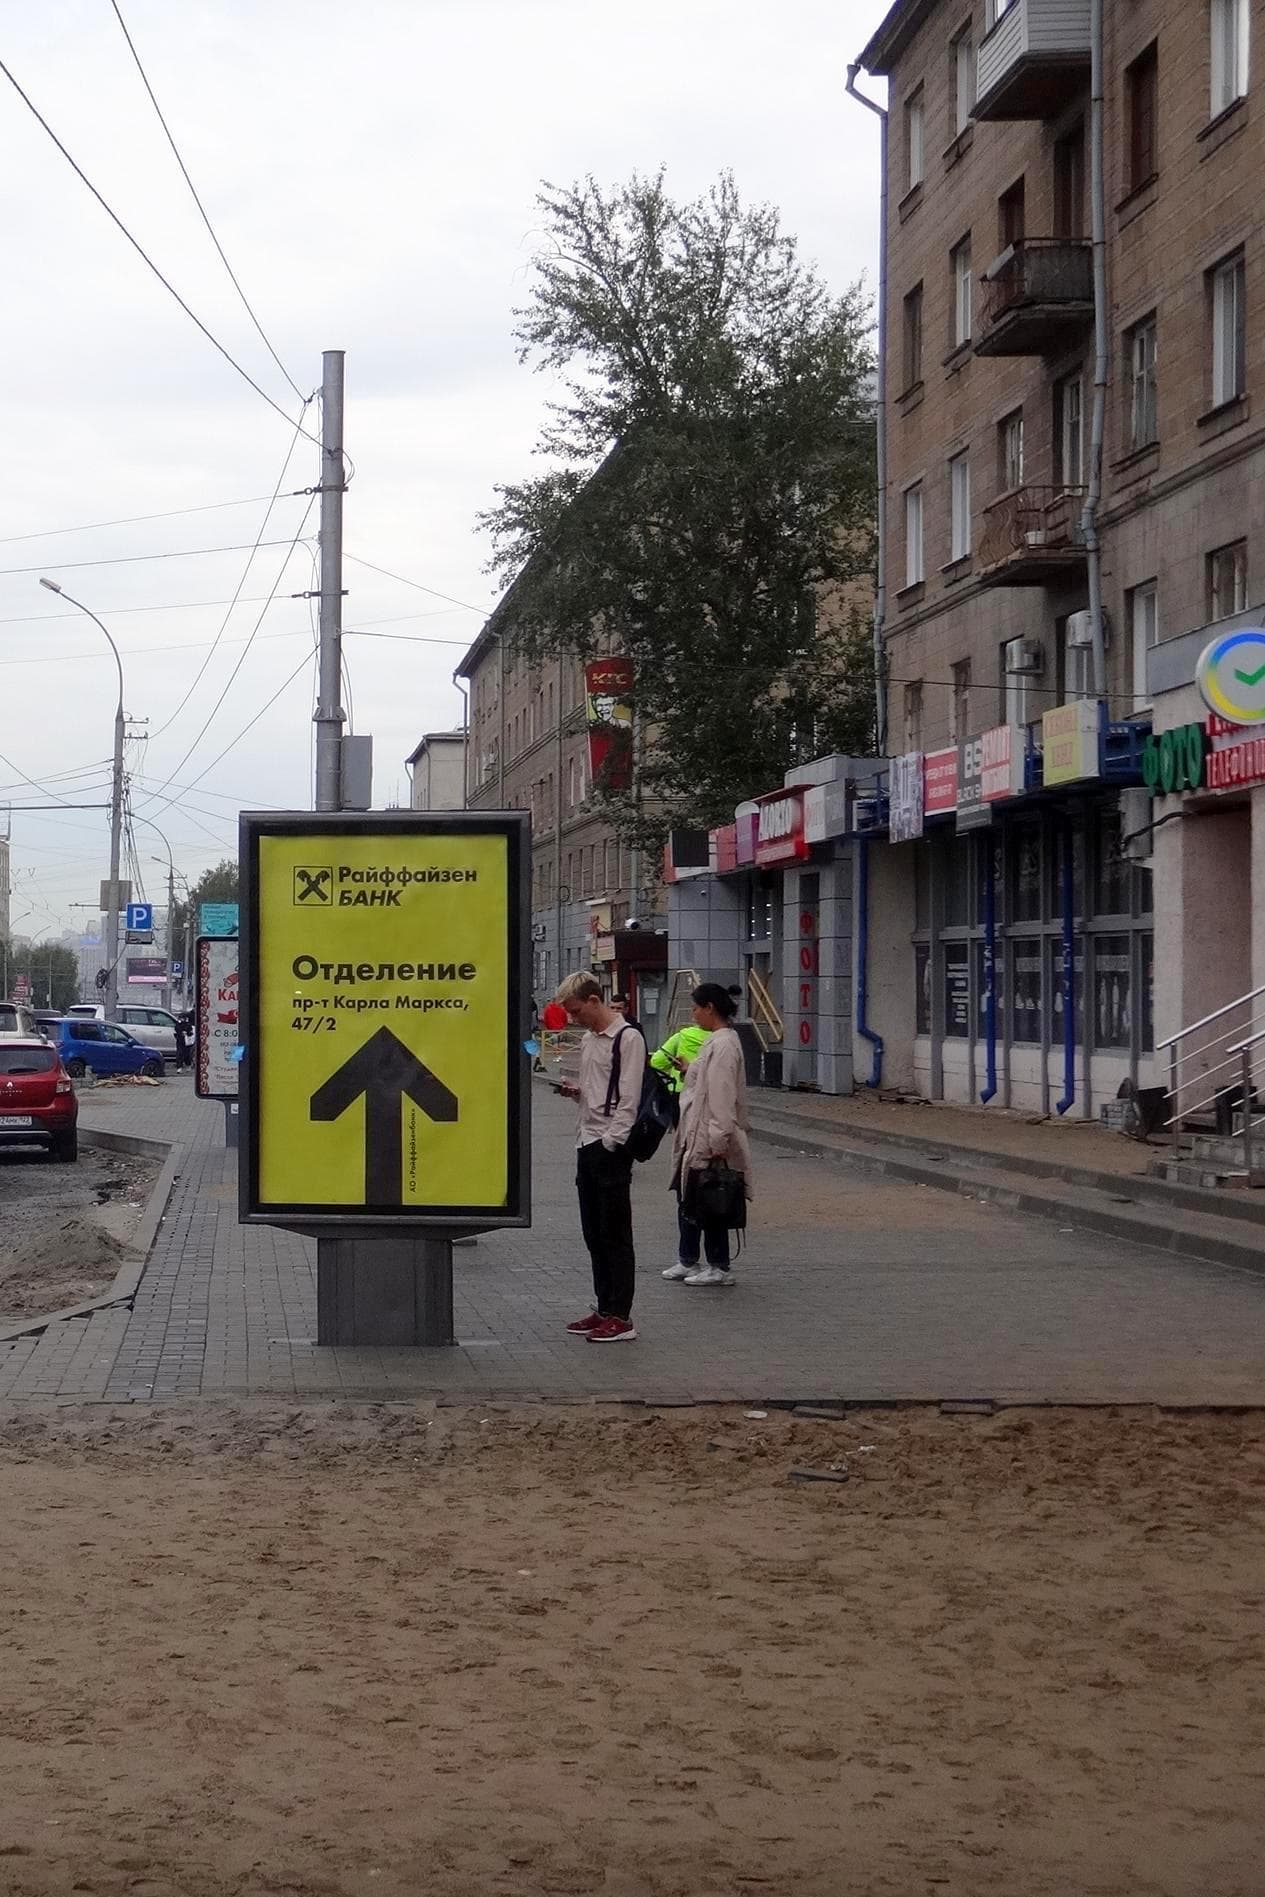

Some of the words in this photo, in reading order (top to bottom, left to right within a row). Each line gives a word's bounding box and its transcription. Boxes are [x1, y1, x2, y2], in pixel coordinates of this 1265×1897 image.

[1143, 722, 1202, 799] ФОТО
[338, 866, 477, 887] Райффайзен
[338, 890, 404, 907] БАНК
[132, 907, 148, 929] P
[292, 955, 477, 984] Отделение
[800, 911, 814, 1045] ФОТО
[292, 997, 329, 1012] пр-т
[333, 996, 390, 1013] Карла
[395, 996, 469, 1013] Маркса,
[291, 1016, 337, 1034] 47/2
